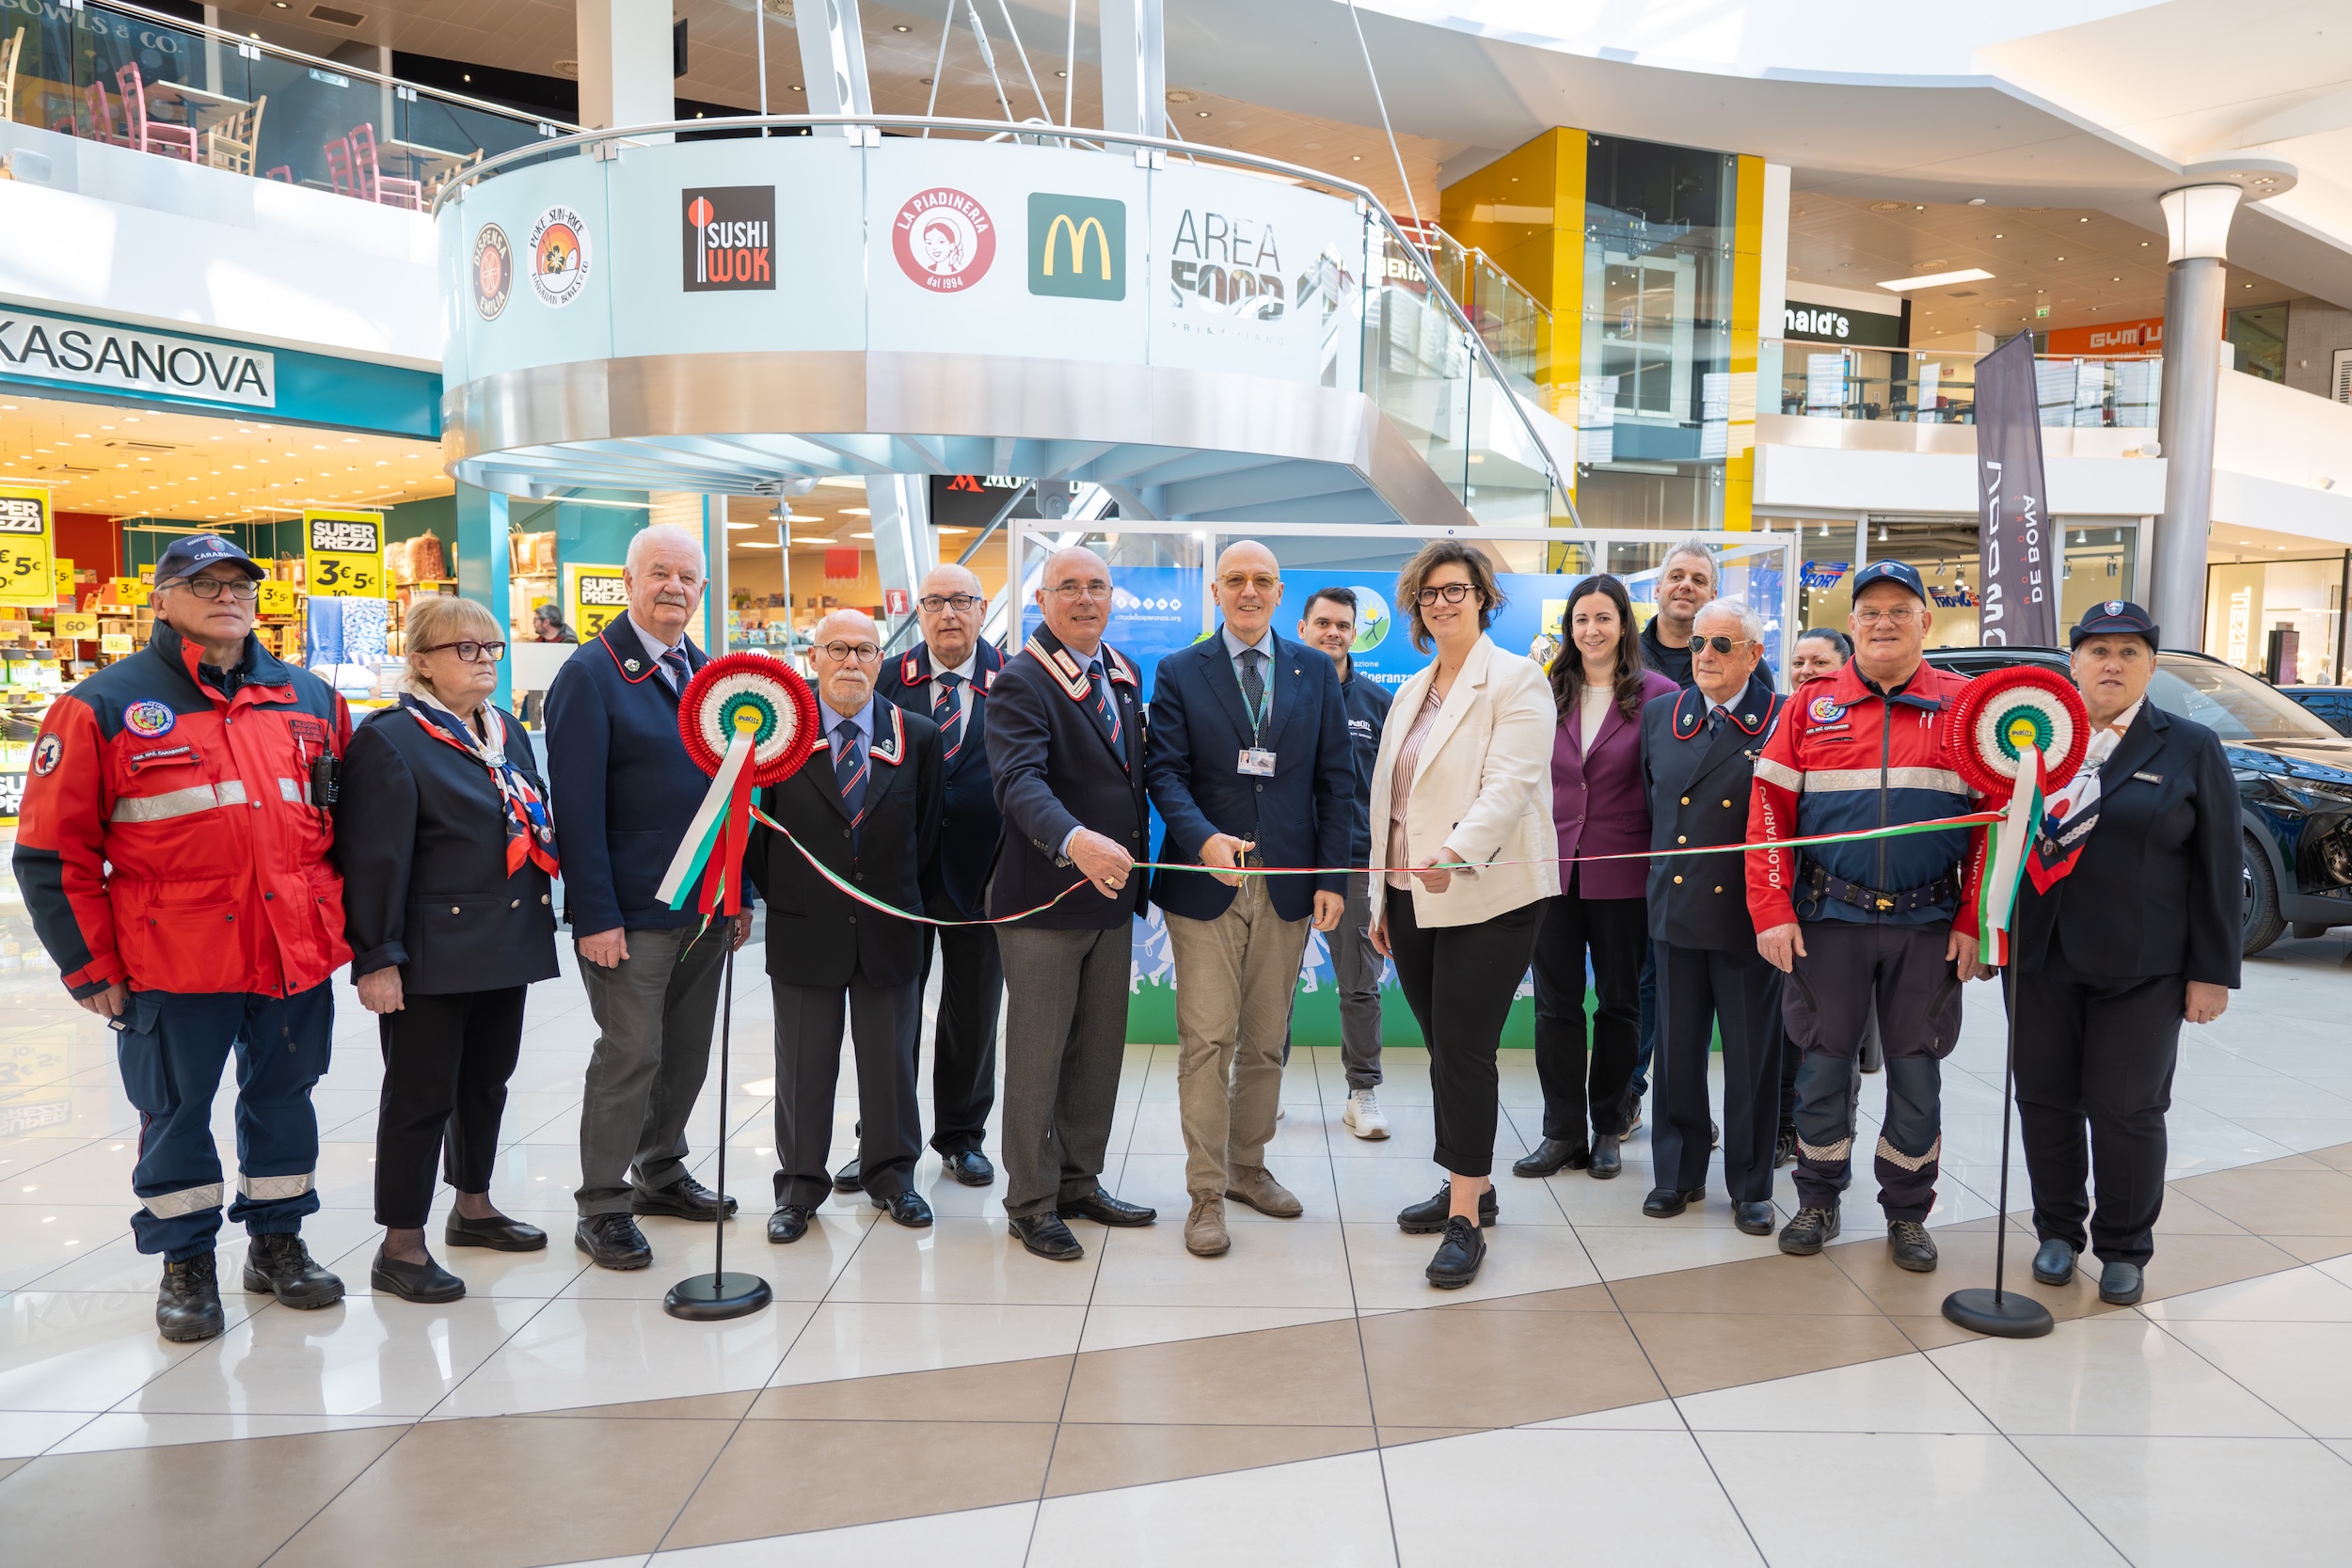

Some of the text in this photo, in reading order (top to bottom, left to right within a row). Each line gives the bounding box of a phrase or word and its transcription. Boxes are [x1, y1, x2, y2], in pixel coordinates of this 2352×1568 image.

[897, 192, 989, 234] LA PIADINERIA
[530, 208, 585, 249] POKE SUN-RICE
[707, 221, 769, 248] SUSHI
[1171, 209, 1280, 273] AREA
[473, 230, 506, 267] DISPENSA
[707, 247, 771, 282] WOK
[532, 271, 558, 305] HAWAIIAN
[927, 276, 963, 289] dal 1994
[1171, 259, 1285, 321] FOOD
[479, 290, 506, 315] EMILIA
[0, 321, 268, 397] KASANOVA
[312, 521, 375, 539] SUPER
[312, 535, 377, 552] PREZZI
[194, 551, 236, 561] CARABIN
[581, 578, 626, 593] SUPE
[581, 591, 629, 605] PREZZ
[1114, 613, 1182, 623] cittadellasperanza.org
